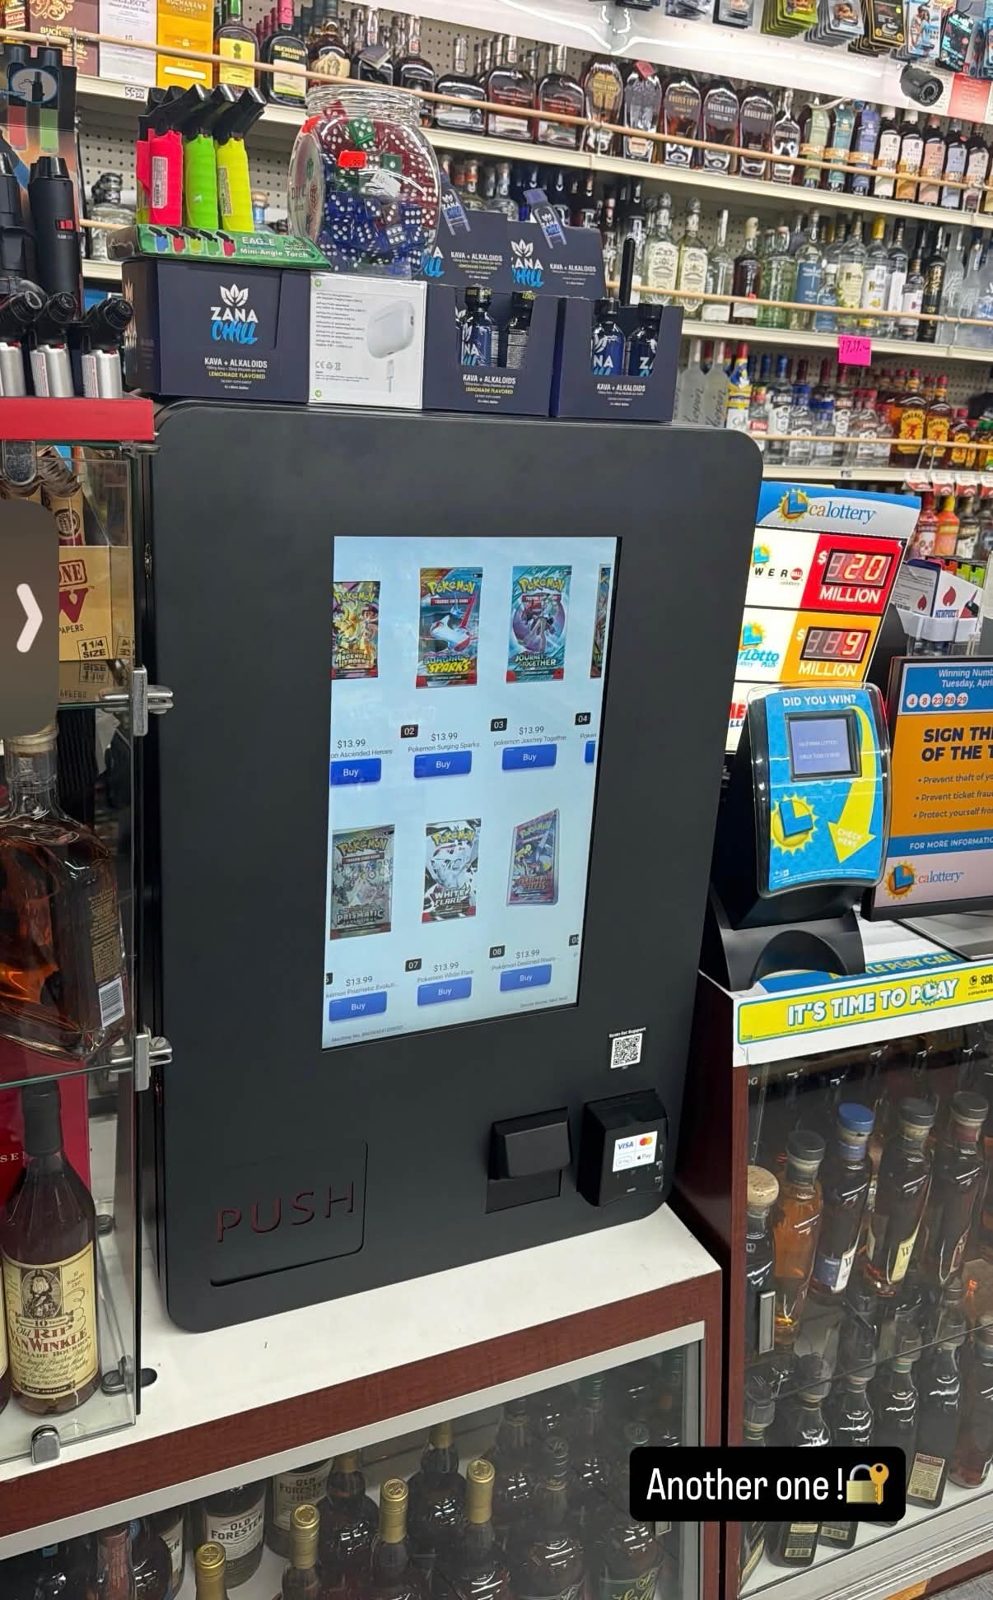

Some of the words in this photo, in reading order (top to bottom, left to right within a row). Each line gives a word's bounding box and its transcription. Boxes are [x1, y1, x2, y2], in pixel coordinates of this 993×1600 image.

[242, 236, 275, 246] EAGE
[285, 250, 308, 258] Torch
[210, 307, 258, 323] ZANA
[210, 320, 258, 344] CHILL
[204, 357, 222, 366] KAVA
[230, 359, 268, 369] ALKALOIDS
[463, 374, 478, 383] KAVA
[484, 375, 516, 385] ALKALOIDS
[597, 383, 611, 391] KAVA
[616, 384, 646, 393] ALKALOIDS
[808, 501, 877, 525] calottery
[819, 586, 881, 604] MILLION
[83, 649, 106, 659] SIZE
[427, 660, 471, 673] SPARKS
[799, 661, 857, 678] MILLION
[938, 669, 971, 679] Winning
[942, 679, 975, 689] Tuesday,
[783, 696, 801, 707] DID
[804, 695, 827, 705] YOU
[830, 694, 857, 704] WIN?
[493, 721, 504, 729] 03
[404, 727, 415, 736] 02
[519, 726, 545, 736] $13.99
[923, 728, 964, 743] SIGN
[431, 732, 458, 742] $13.99
[337, 739, 366, 749] $13.99
[522, 753, 537, 763] Buy
[922, 747, 946, 762] OF
[951, 745, 982, 760] THE
[436, 760, 451, 770] Buy
[343, 768, 359, 778] Buy
[923, 775, 953, 784] Prevent
[956, 774, 974, 782] theft
[921, 792, 952, 802] Prevent
[953, 791, 975, 800] ticket
[919, 809, 948, 819] Protect
[949, 807, 979, 818] yourself
[909, 842, 925, 850] FOR
[927, 839, 949, 848] MORE
[918, 870, 961, 884] calottery
[408, 960, 419, 970] 07
[433, 962, 459, 972] $13.99
[345, 975, 373, 987] $13.99
[519, 974, 533, 983] Buy
[438, 987, 452, 997] Buy
[788, 1001, 827, 1026] IT'S
[831, 993, 875, 1017] TIME
[880, 989, 906, 1010] TO
[909, 977, 959, 1005] PLAY
[351, 1002, 366, 1012] Buy
[617, 1141, 634, 1150] VISA
[216, 1181, 354, 1243] PUSH
[35, 1319, 48, 1328] 10
[16, 1327, 31, 1338] Old
[34, 1326, 67, 1339] RIP
[29, 1330, 88, 1352] WINKLE
[211, 1514, 263, 1540] FORESTER
[230, 1517, 250, 1531] OLD
